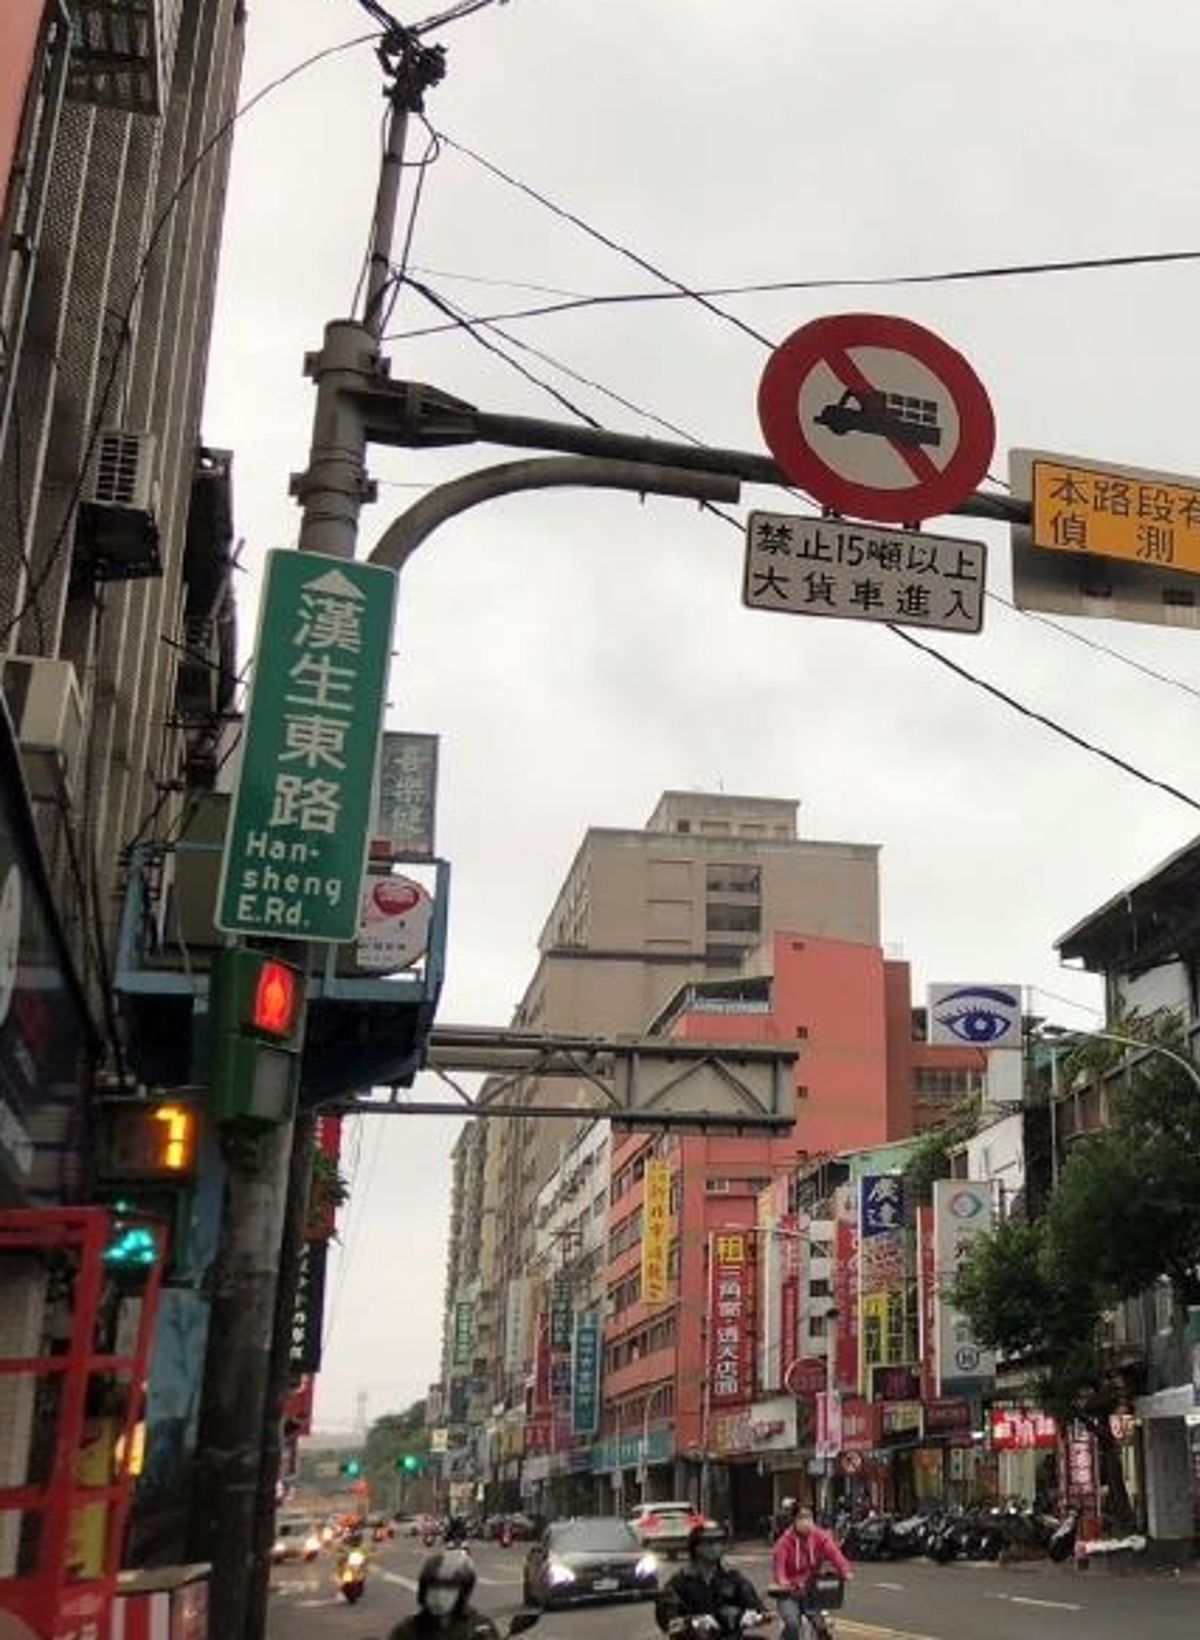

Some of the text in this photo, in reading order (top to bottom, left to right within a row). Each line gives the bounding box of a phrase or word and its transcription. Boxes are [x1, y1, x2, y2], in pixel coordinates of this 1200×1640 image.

[755, 521, 978, 583] 禁止15噸以上
[752, 567, 974, 621] 大貨車進入
[266, 595, 366, 835] 漢生東路
[245, 831, 320, 861] Han-
[241, 866, 343, 906] sheng
